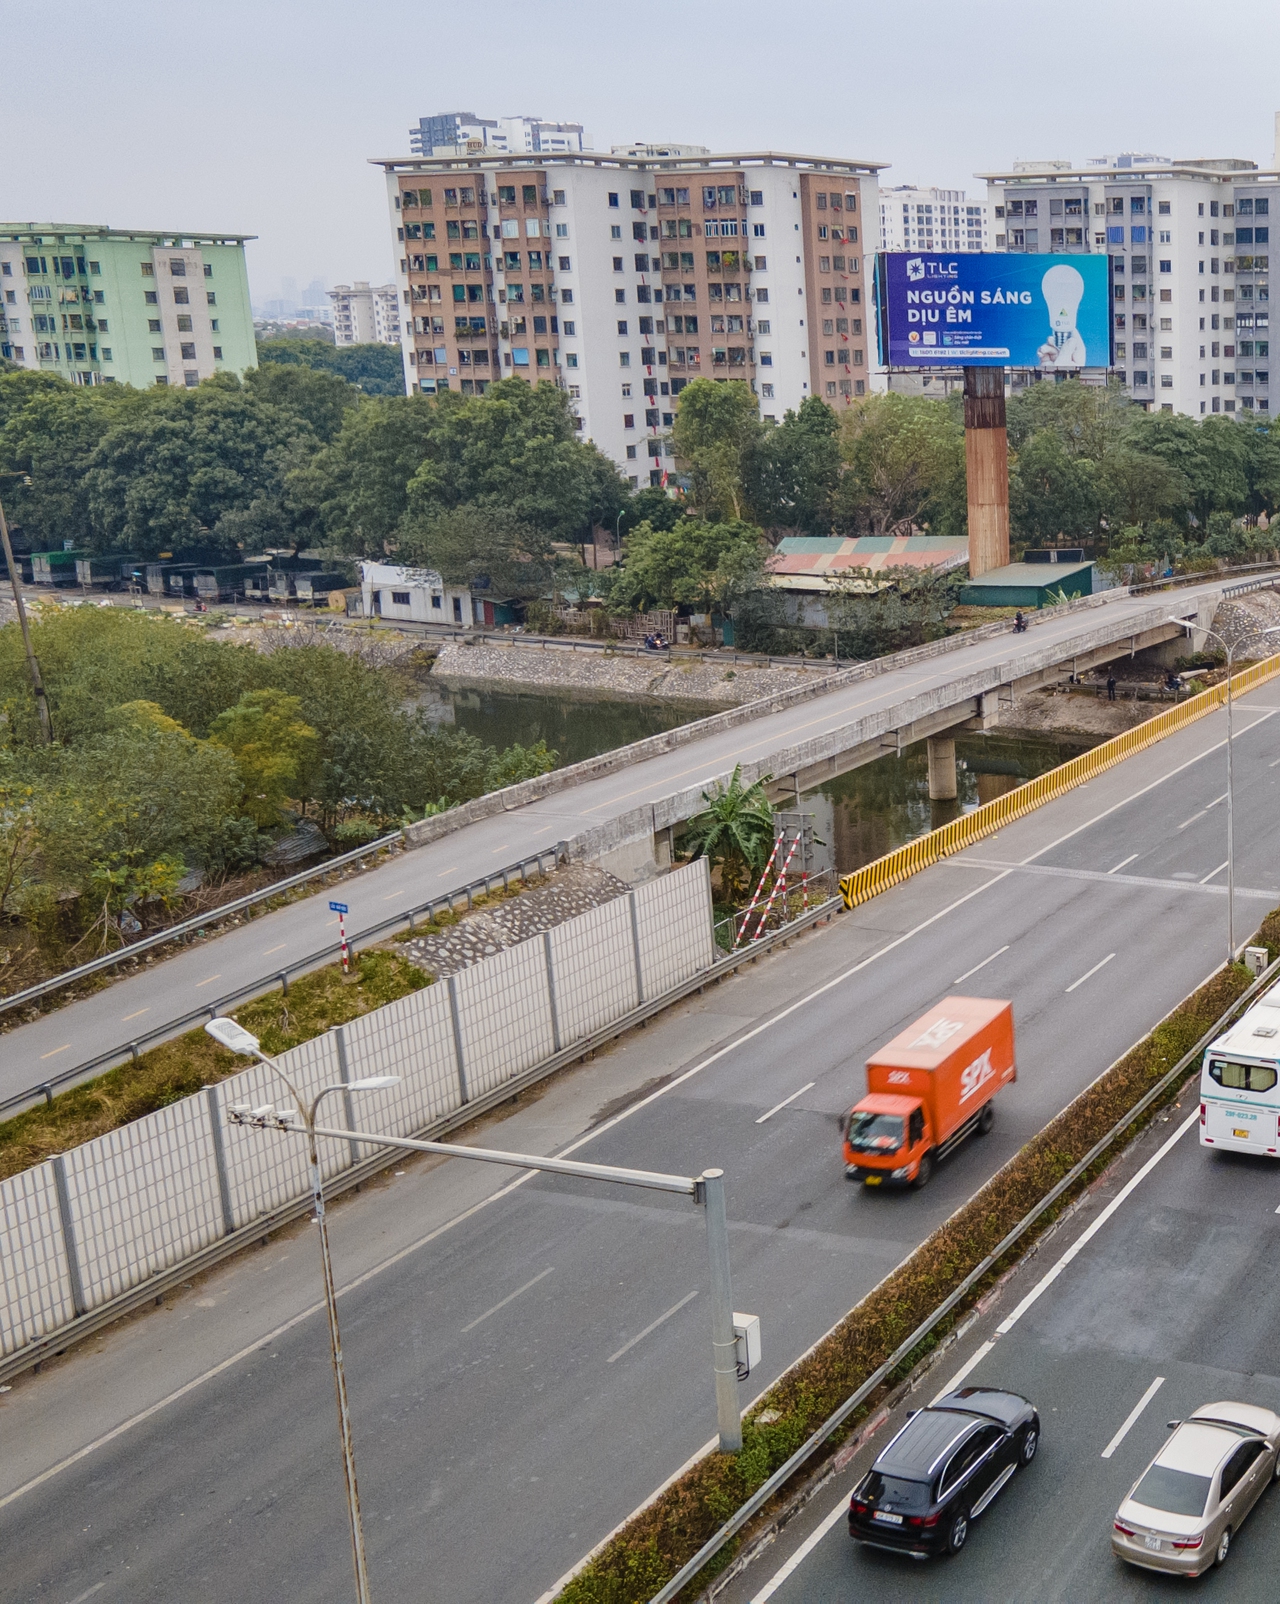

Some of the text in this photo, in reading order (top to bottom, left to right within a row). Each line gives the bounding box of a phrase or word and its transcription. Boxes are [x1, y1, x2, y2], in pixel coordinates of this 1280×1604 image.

[927, 262, 958, 274] TLC
[907, 285, 1032, 304] NGUỒN SÁNG
[908, 306, 972, 326] DỊU ÊM
[959, 1046, 996, 1098] SPX
